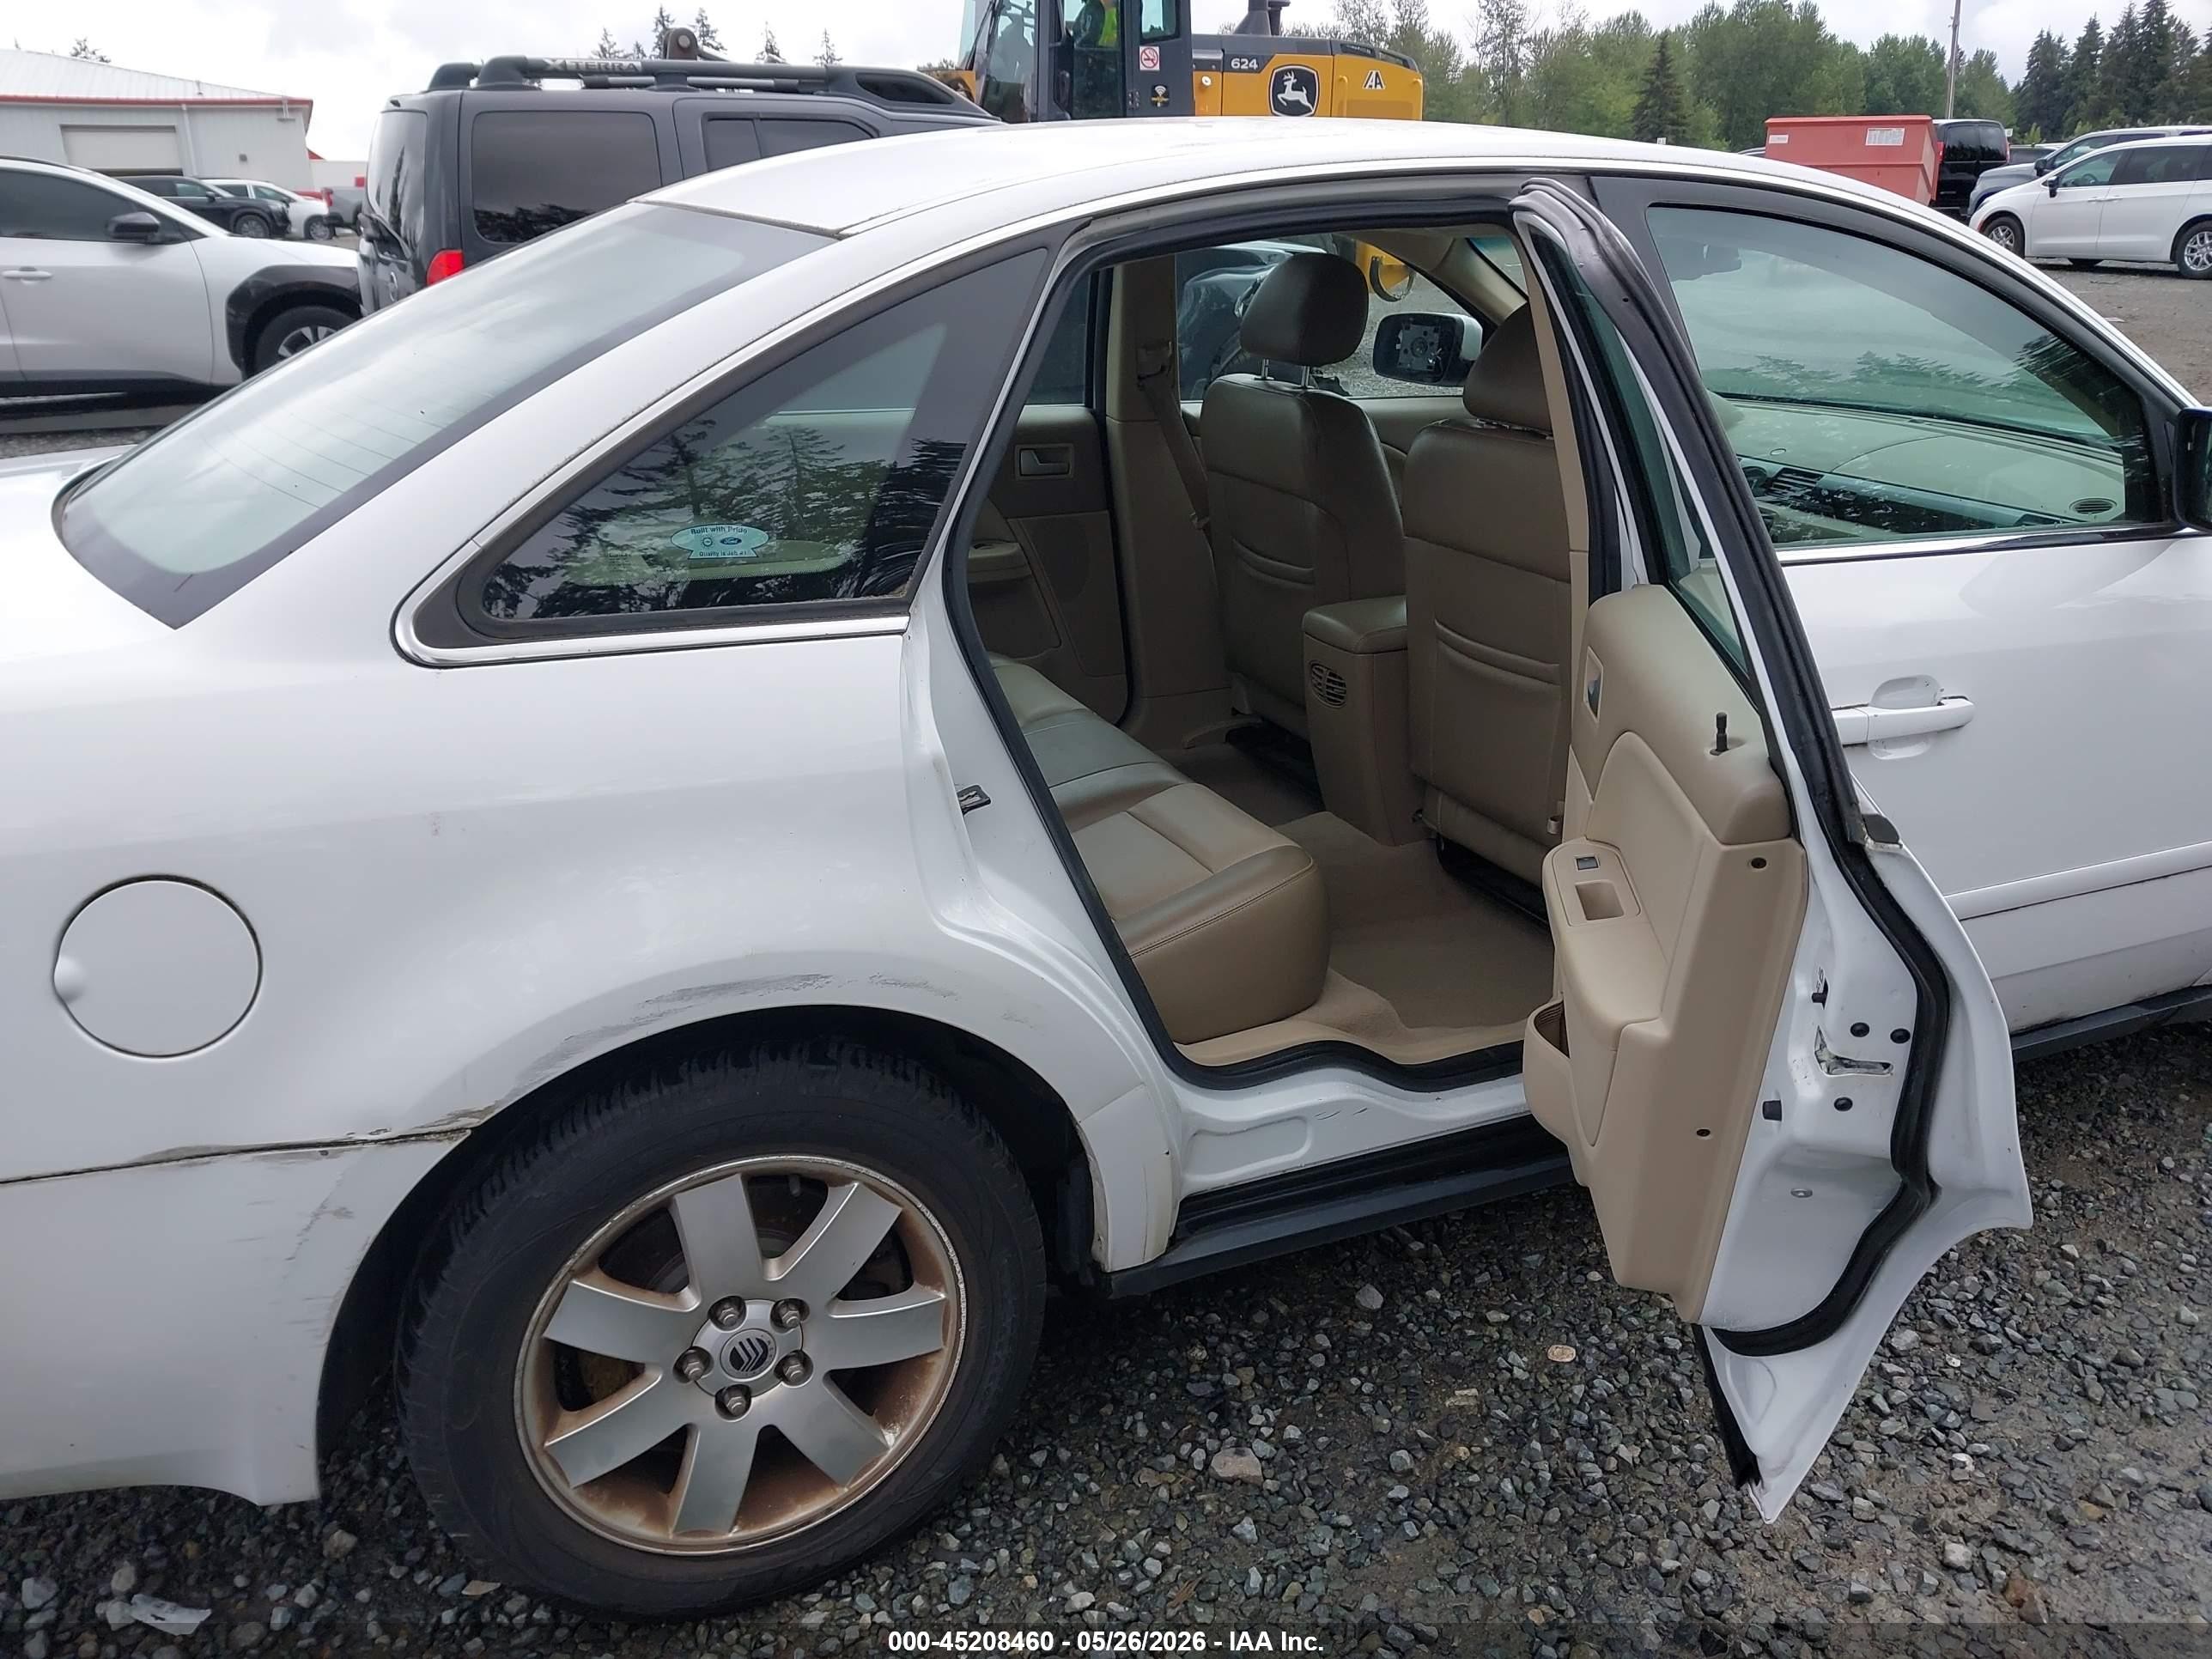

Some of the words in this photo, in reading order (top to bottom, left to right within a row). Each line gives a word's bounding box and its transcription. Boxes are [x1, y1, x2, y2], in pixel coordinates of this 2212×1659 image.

[543, 58, 641, 72] XTERRA
[1231, 58, 1259, 70] 624
[690, 526, 708, 535] Built
[727, 526, 748, 534] Pride
